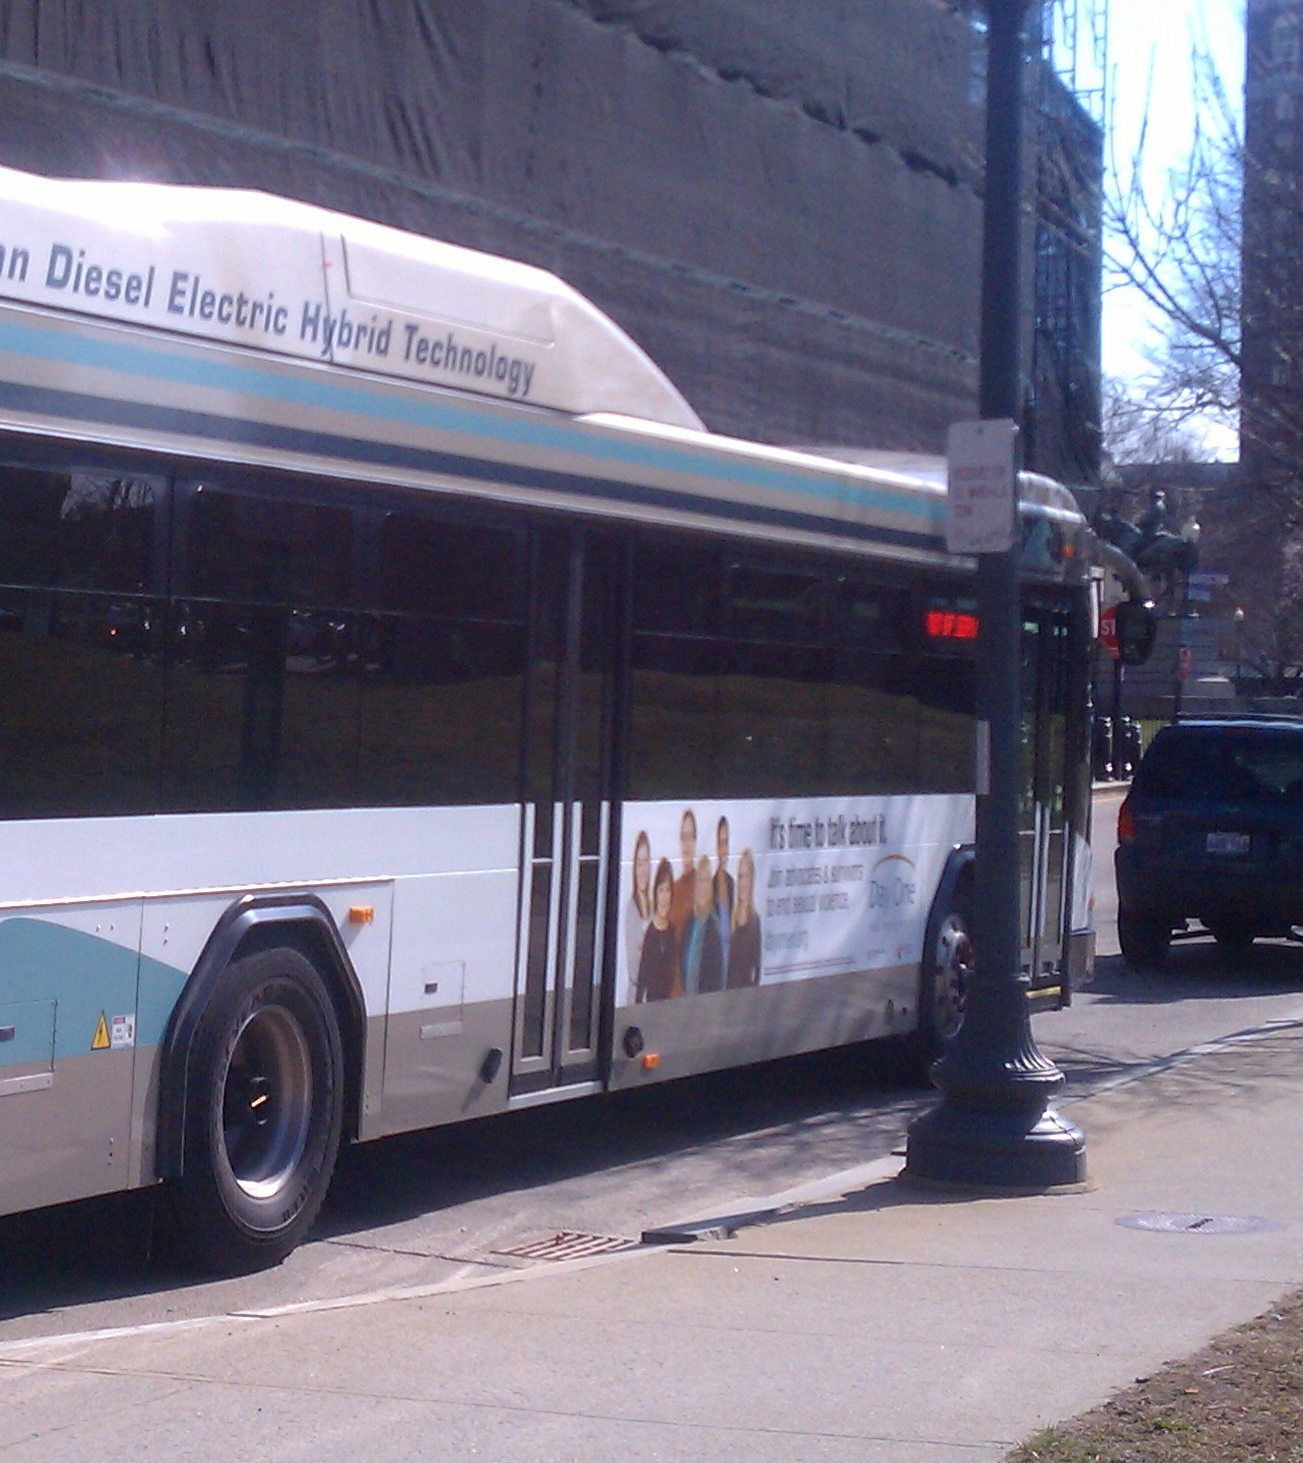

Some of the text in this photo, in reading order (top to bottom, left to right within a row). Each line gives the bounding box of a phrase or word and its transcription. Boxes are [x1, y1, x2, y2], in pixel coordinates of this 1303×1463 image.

[45, 243, 155, 308] Diesel
[167, 270, 289, 336] Electric
[299, 301, 393, 357] Hybrid
[403, 324, 536, 397] Technology
[1101, 619, 1116, 635] ST
[789, 816, 812, 848] time
[814, 817, 825, 847] to
[828, 815, 845, 846] talk
[849, 815, 877, 845] about
